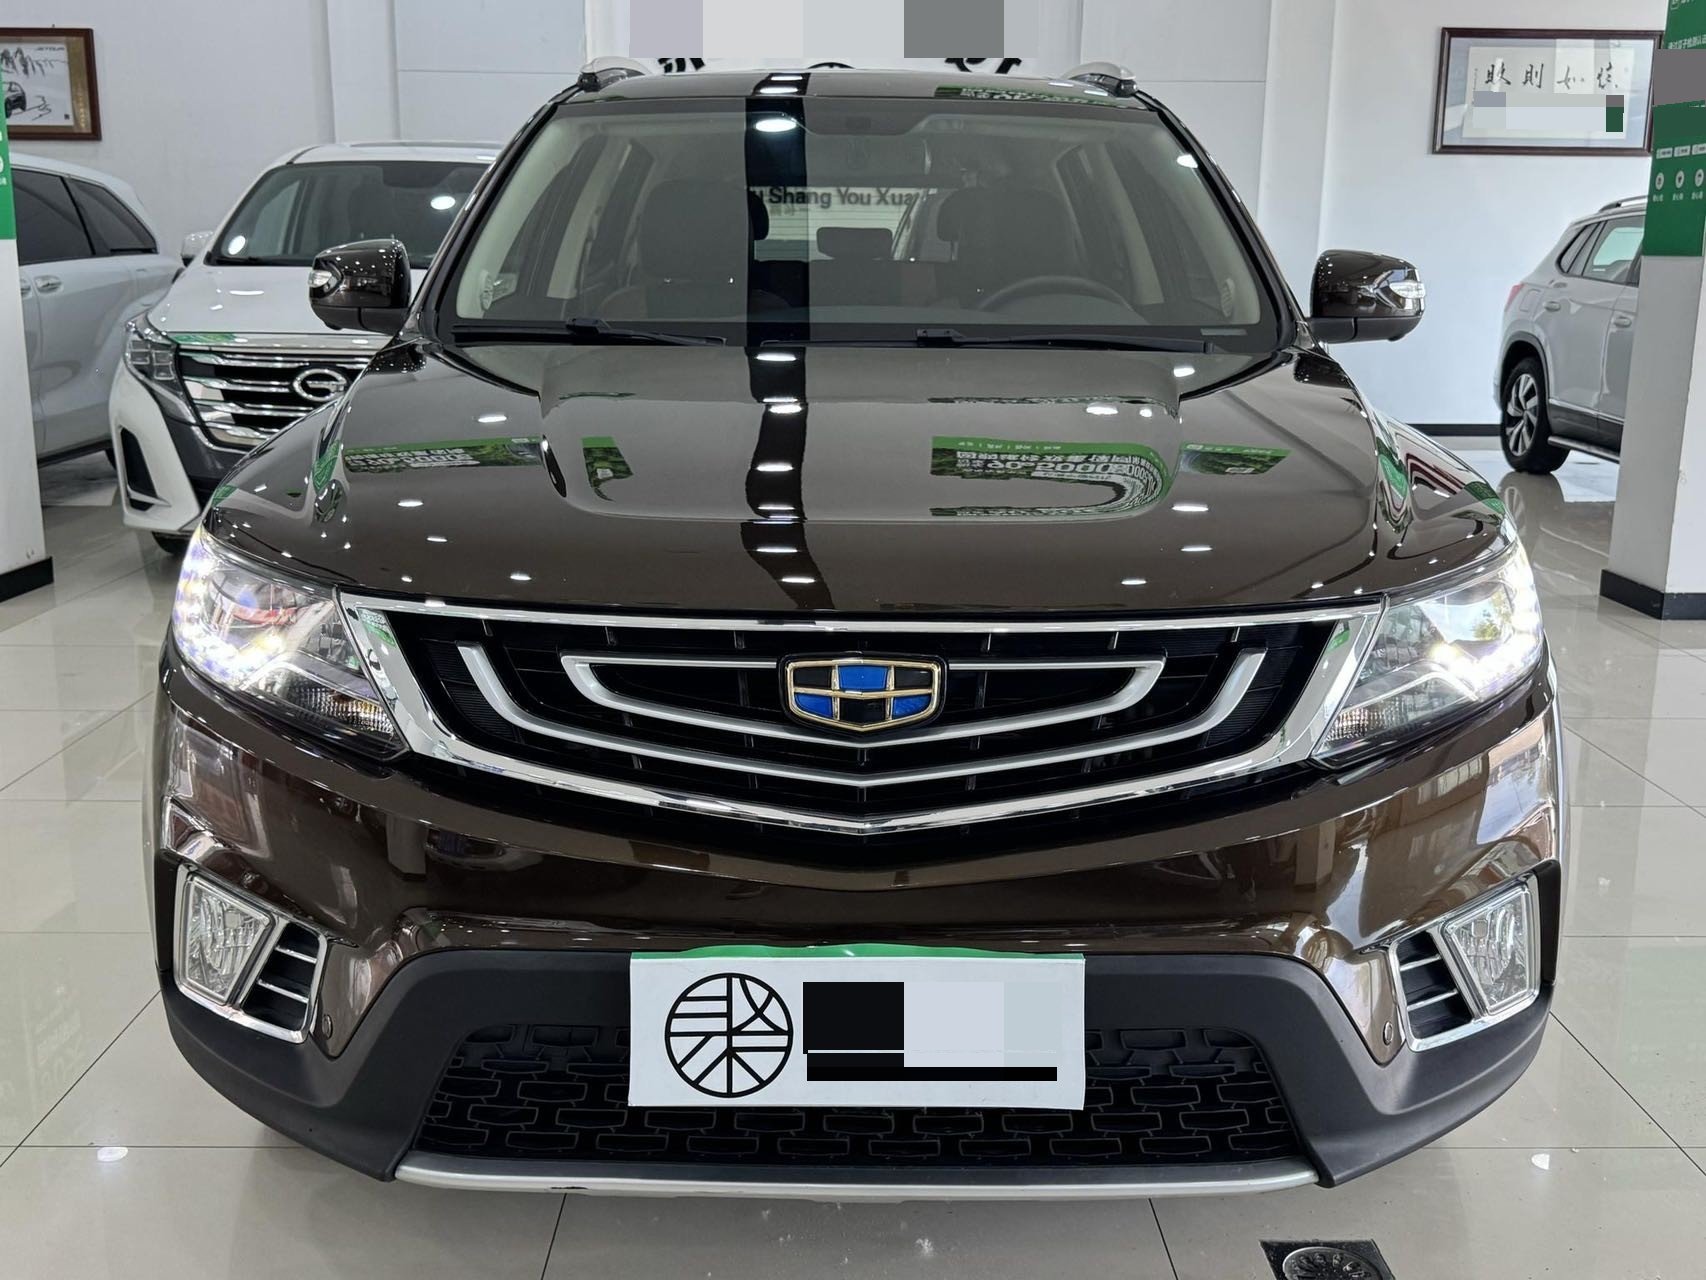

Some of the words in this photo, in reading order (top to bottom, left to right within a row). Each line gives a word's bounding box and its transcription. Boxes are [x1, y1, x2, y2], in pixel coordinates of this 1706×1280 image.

[769, 186, 832, 208] Shang
[836, 187, 871, 206] You
[876, 187, 920, 206] Xua
